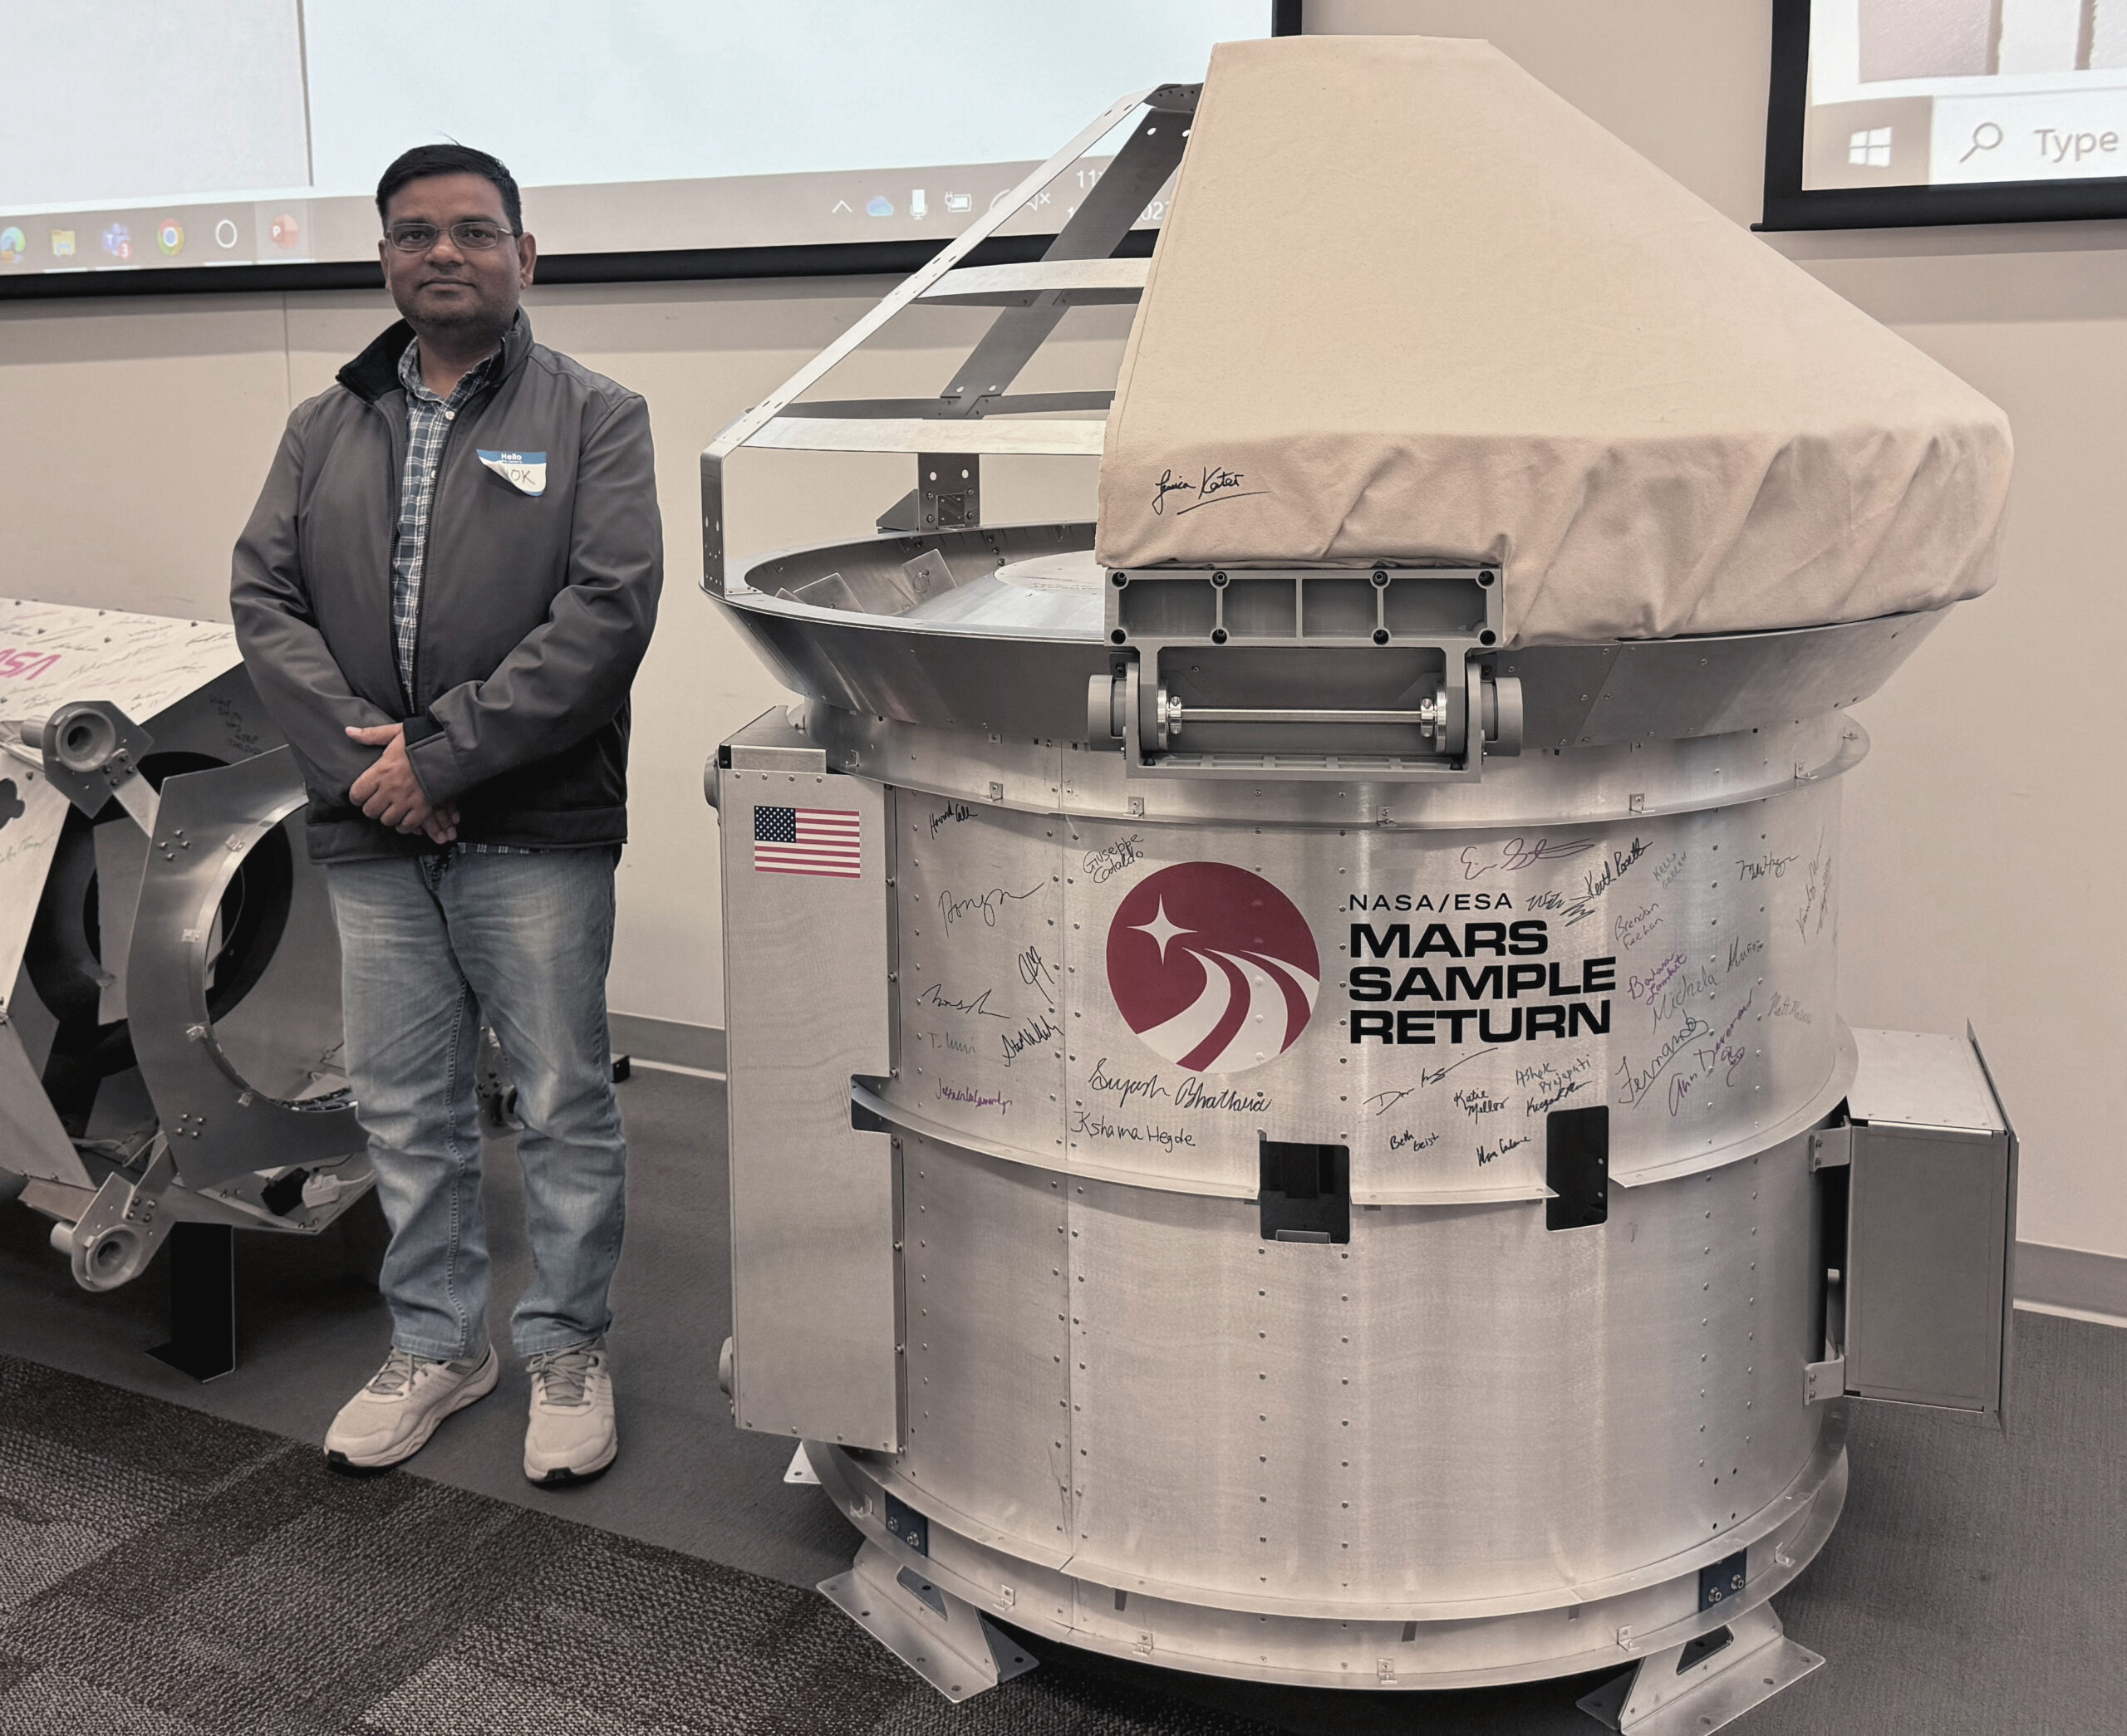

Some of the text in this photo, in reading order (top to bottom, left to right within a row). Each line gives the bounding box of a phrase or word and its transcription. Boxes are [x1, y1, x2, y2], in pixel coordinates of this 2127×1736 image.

[2033, 128, 2119, 163] Type
[501, 453, 522, 461] Hello
[1349, 892, 1512, 913] NASA/ESA
[1350, 919, 1548, 959] MARS
[1349, 956, 1617, 1002] SAMPLE
[1350, 999, 1611, 1045] RETURN
